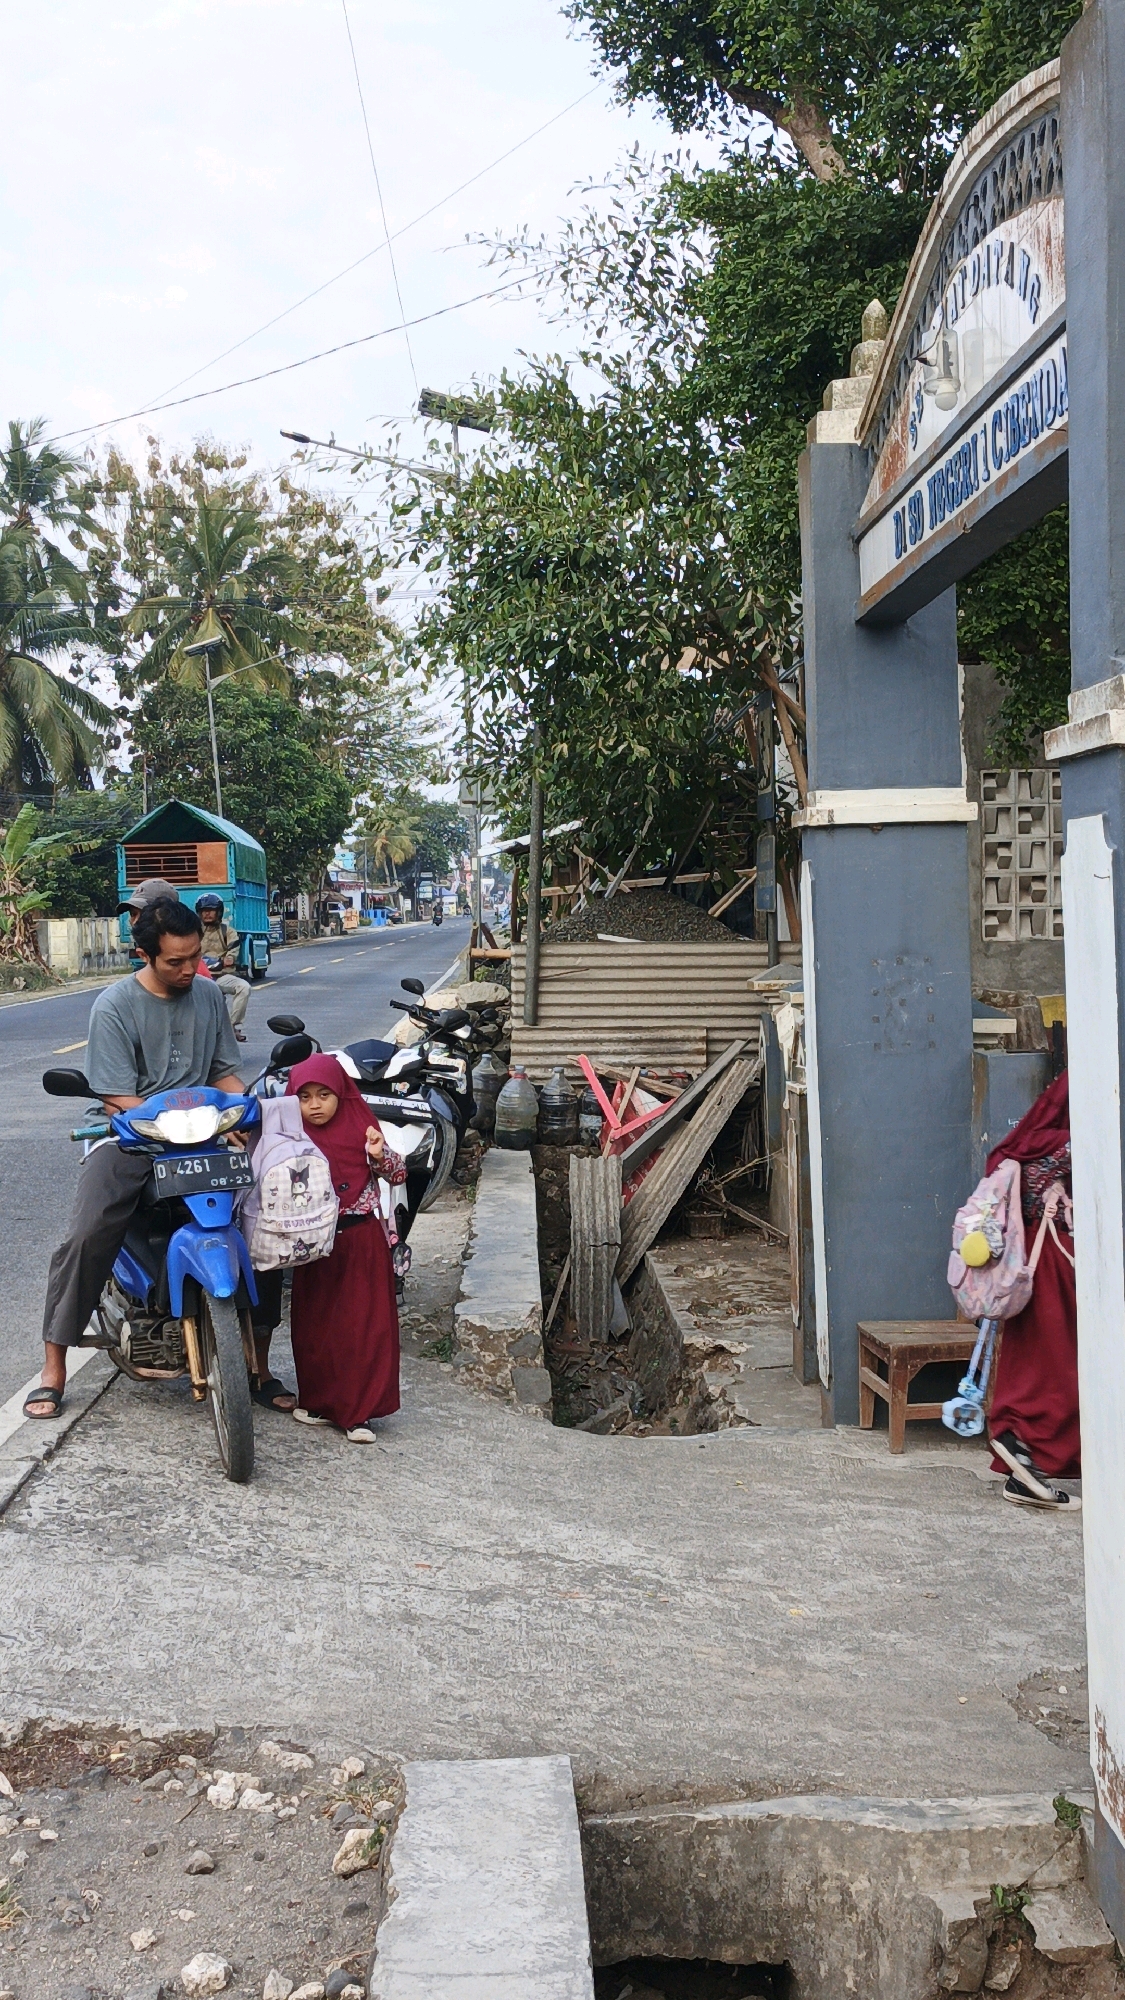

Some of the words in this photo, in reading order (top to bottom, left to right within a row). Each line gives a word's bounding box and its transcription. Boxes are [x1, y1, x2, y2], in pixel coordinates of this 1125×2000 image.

[971, 239, 1042, 325] DATANG
[893, 505, 907, 560] DI
[908, 489, 924, 546] SD
[927, 433, 980, 531] NEGERI
[157, 1164, 167, 1179] D
[176, 1158, 211, 1175] 4261
[229, 1154, 249, 1170] CW
